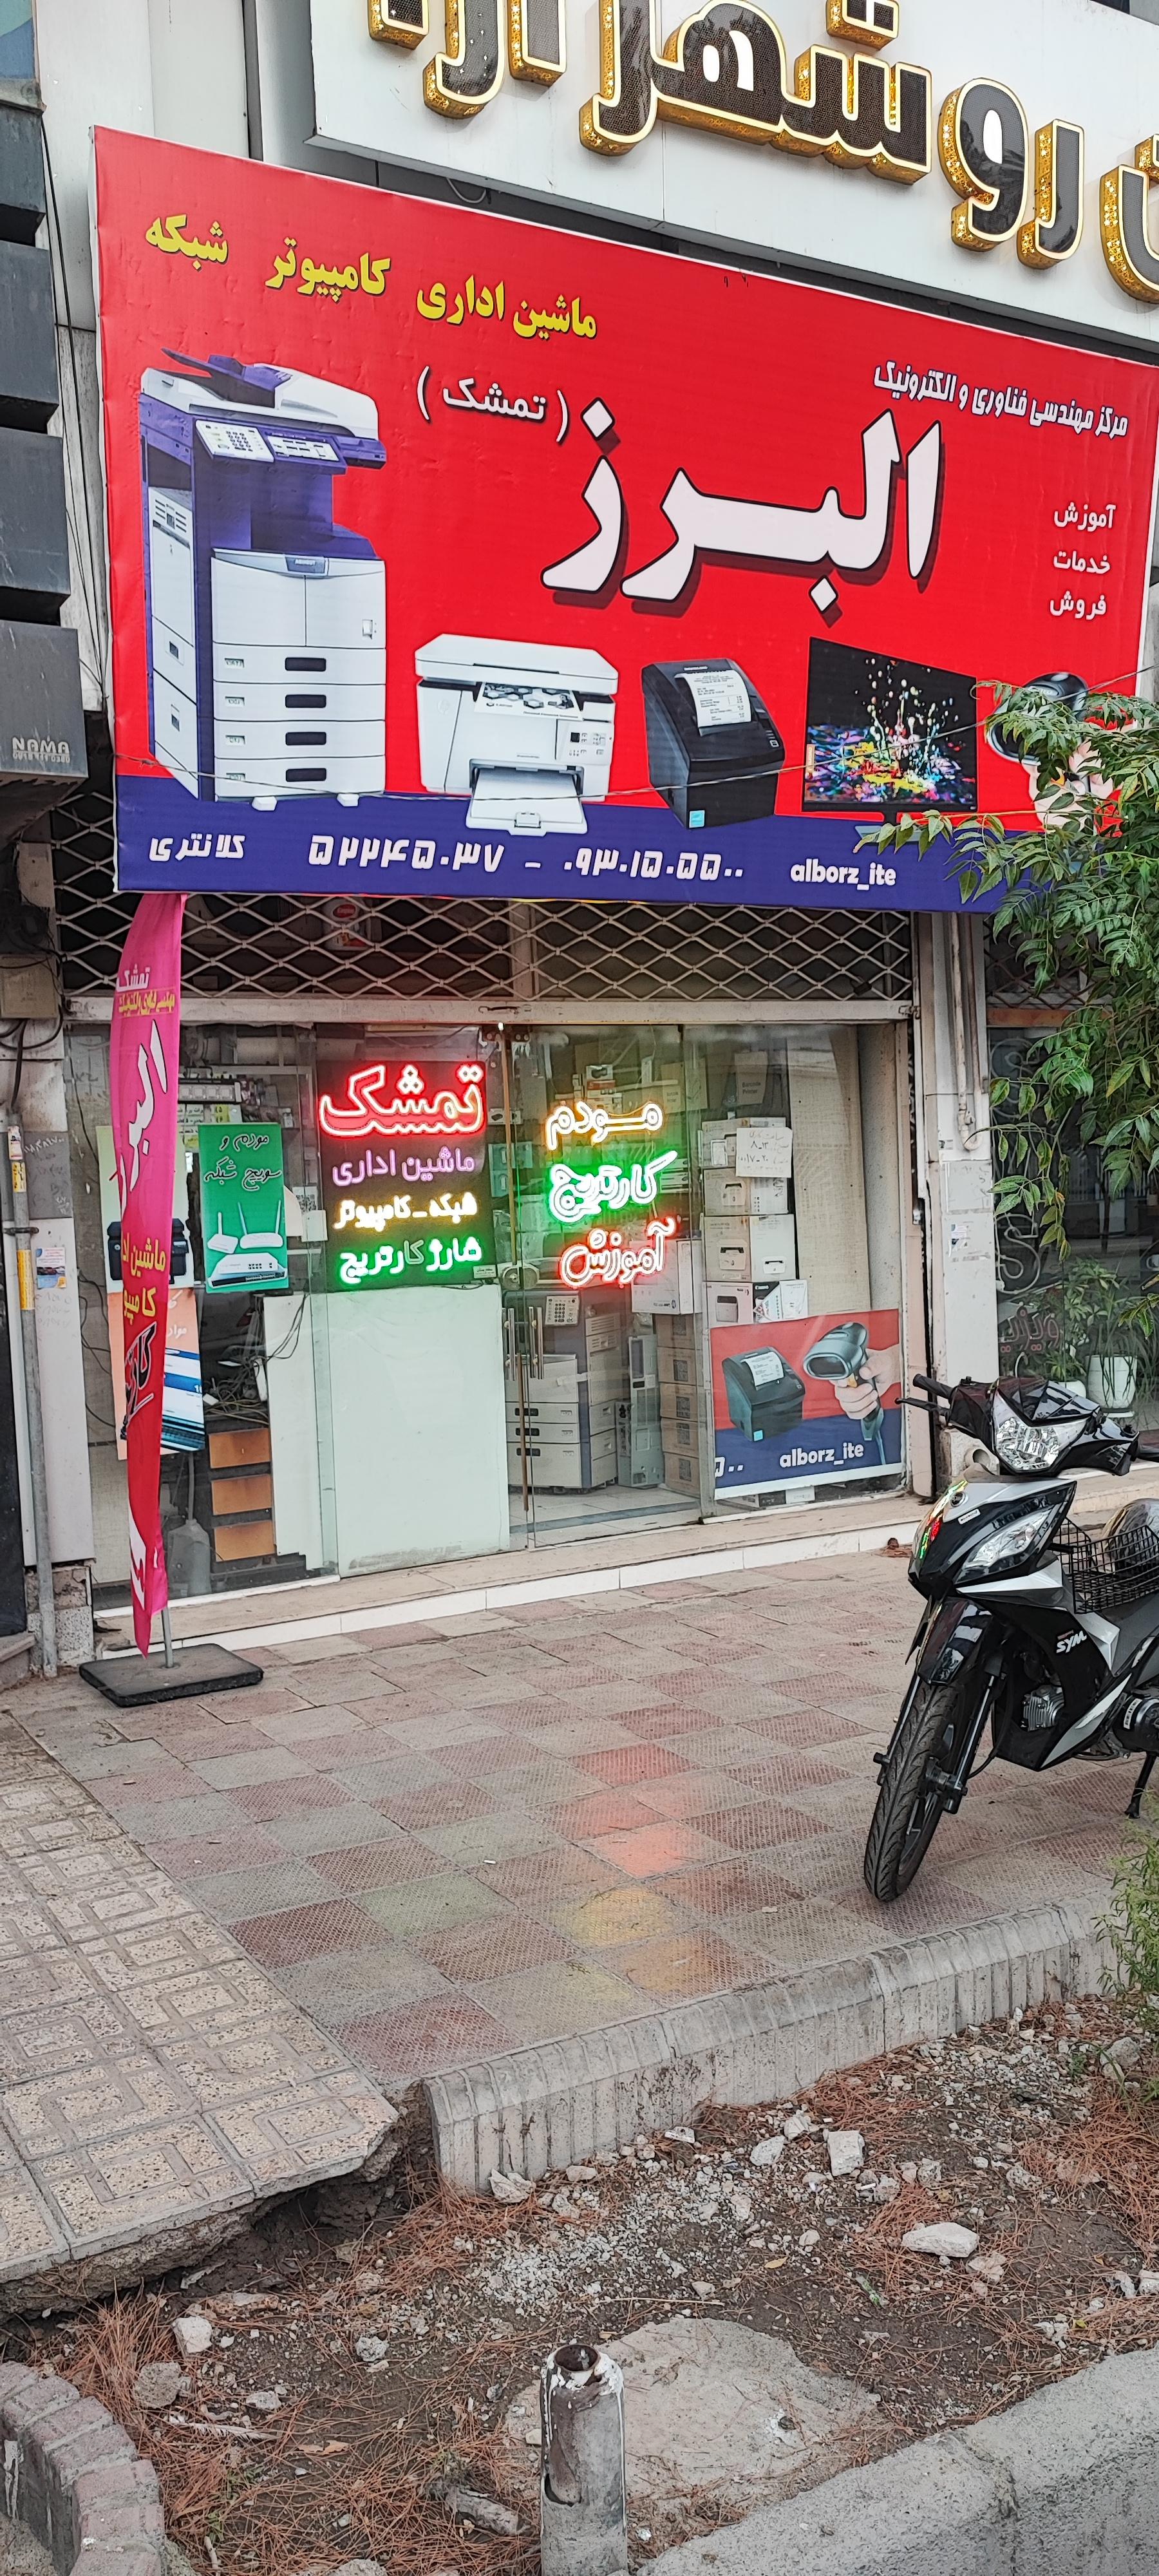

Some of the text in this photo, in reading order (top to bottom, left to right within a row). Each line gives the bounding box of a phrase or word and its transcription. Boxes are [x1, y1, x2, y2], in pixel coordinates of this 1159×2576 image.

[145, 215, 597, 339] ماشین اداری کامپیوتر شبکه
[442, 377, 547, 421] تمشک
[874, 361, 1128, 439] مرکز مهندسی فناوری و الکترونیک
[542, 397, 944, 616] البرز
[1053, 502, 1117, 533] آموزش
[1053, 549, 1111, 576] خدمات
[1050, 591, 1107, 621] فروش
[12, 735, 70, 754] NAMA
[148, 831, 246, 863] کلانتری
[790, 857, 897, 891] alborz_ite
[319, 1063, 484, 1137] تمشک
[219, 1133, 269, 1152] مودم و
[545, 1101, 663, 1151] مودم
[203, 1156, 237, 1185] شبکه
[332, 1146, 475, 1186] ماشین اداری
[549, 1150, 678, 1223] کارتریج
[334, 1194, 412, 1233] کامپیوتر
[429, 1191, 478, 1224] شبکه
[130, 1238, 167, 1278] ماشین
[339, 1236, 482, 1284] شارژ کارتریج
[559, 1216, 675, 1286] آموزش
[779, 1442, 864, 1466] alborz_ite
[1056, 1630, 1088, 1654] SYM
